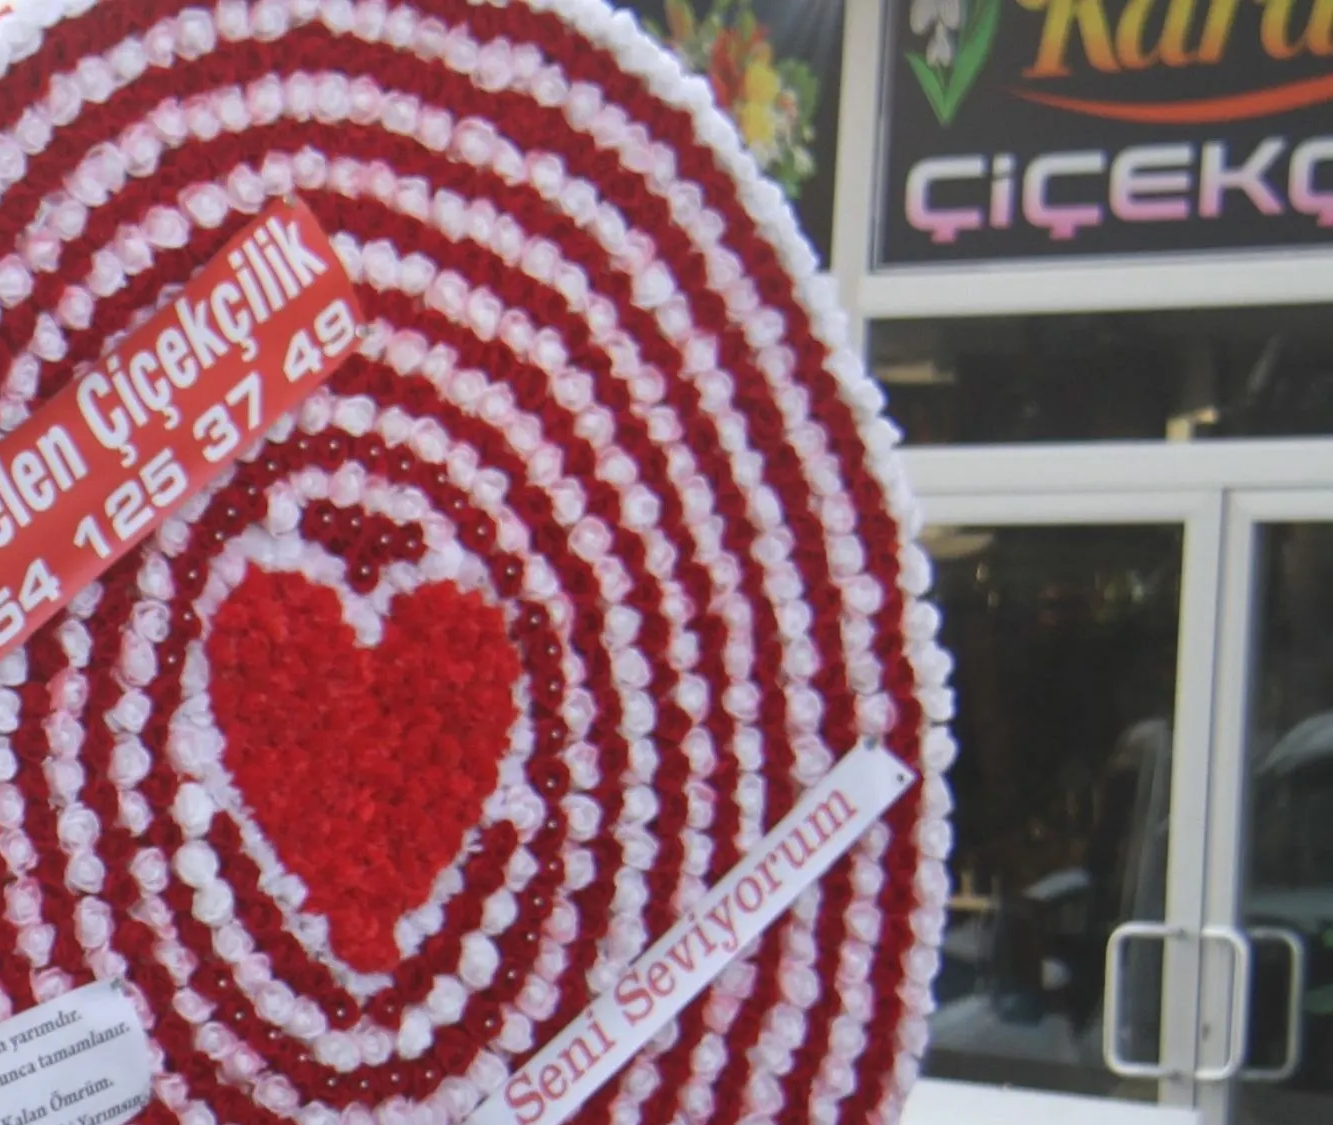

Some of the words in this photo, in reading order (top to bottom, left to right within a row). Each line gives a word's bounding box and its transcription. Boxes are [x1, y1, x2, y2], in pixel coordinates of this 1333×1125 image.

[73, 448, 189, 560] 125
[192, 370, 263, 464] 37
[282, 299, 357, 385] 49
[75, 214, 327, 466] Çiçekçilik
[613, 788, 859, 1026] Seviyorum
[49, 1077, 115, 1112] Ömrüm.
